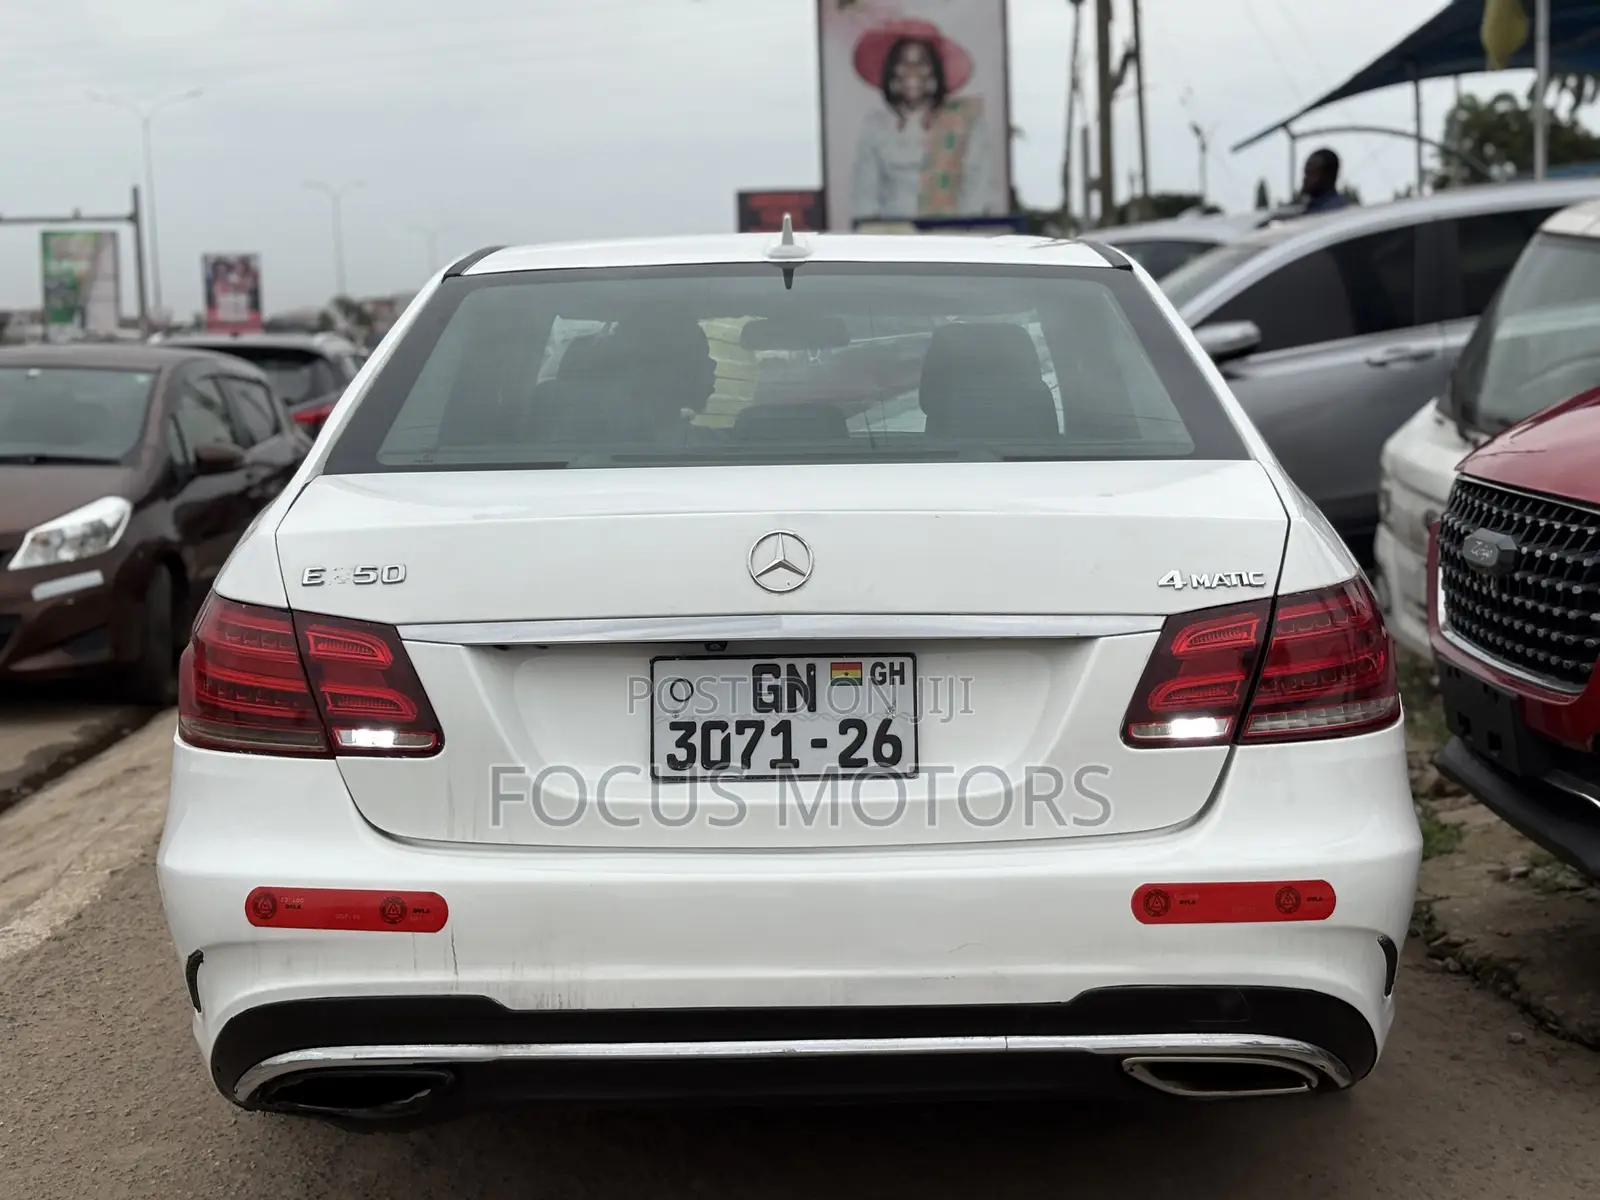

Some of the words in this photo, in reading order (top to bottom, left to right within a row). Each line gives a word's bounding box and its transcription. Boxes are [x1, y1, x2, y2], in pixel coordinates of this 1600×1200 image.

[301, 563, 407, 587] E50
[752, 663, 816, 713] GN
[869, 661, 905, 686] GH
